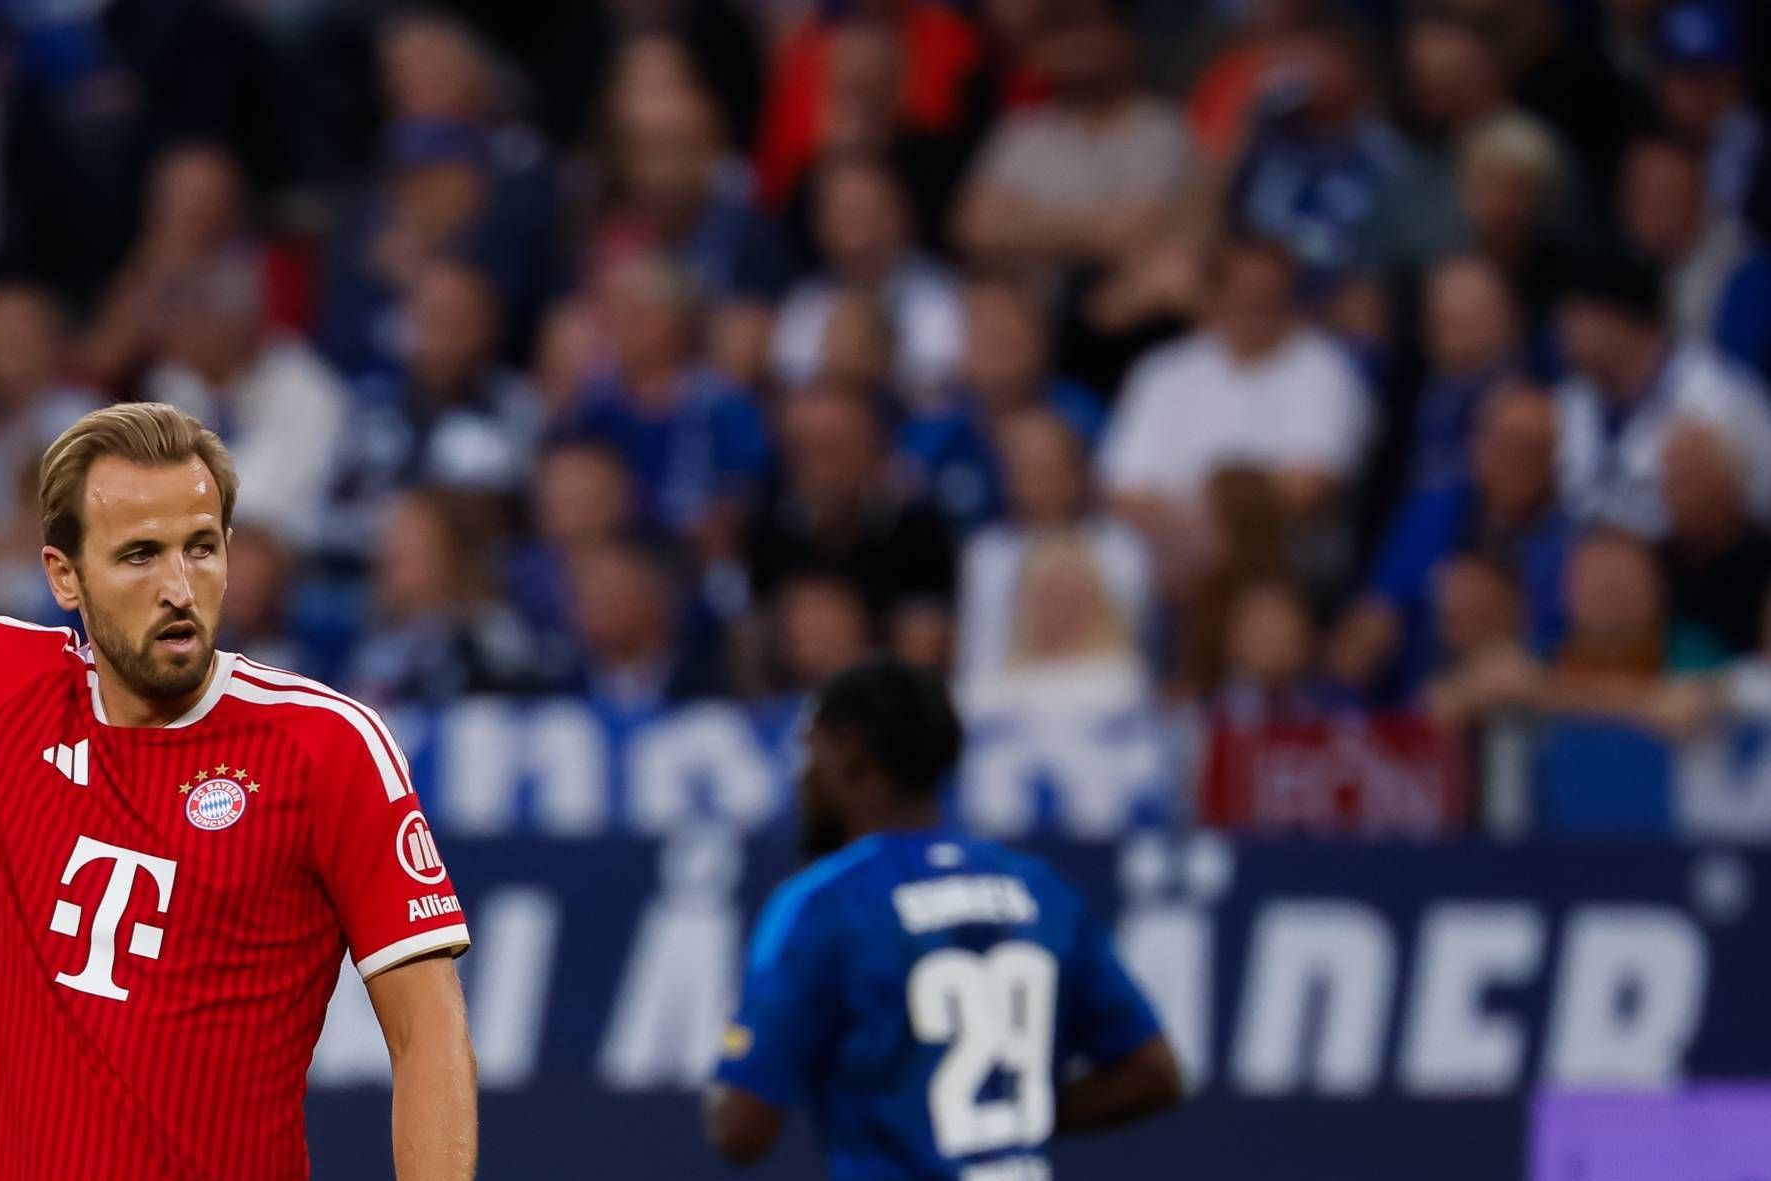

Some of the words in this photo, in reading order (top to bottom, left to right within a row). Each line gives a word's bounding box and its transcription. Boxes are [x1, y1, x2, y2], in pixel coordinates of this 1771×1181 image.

[192, 789, 206, 802] FC
[206, 782, 242, 802] BAYERN
[54, 836, 178, 1002] T
[408, 893, 462, 923] Allian
[906, 939, 1060, 1159] 29
